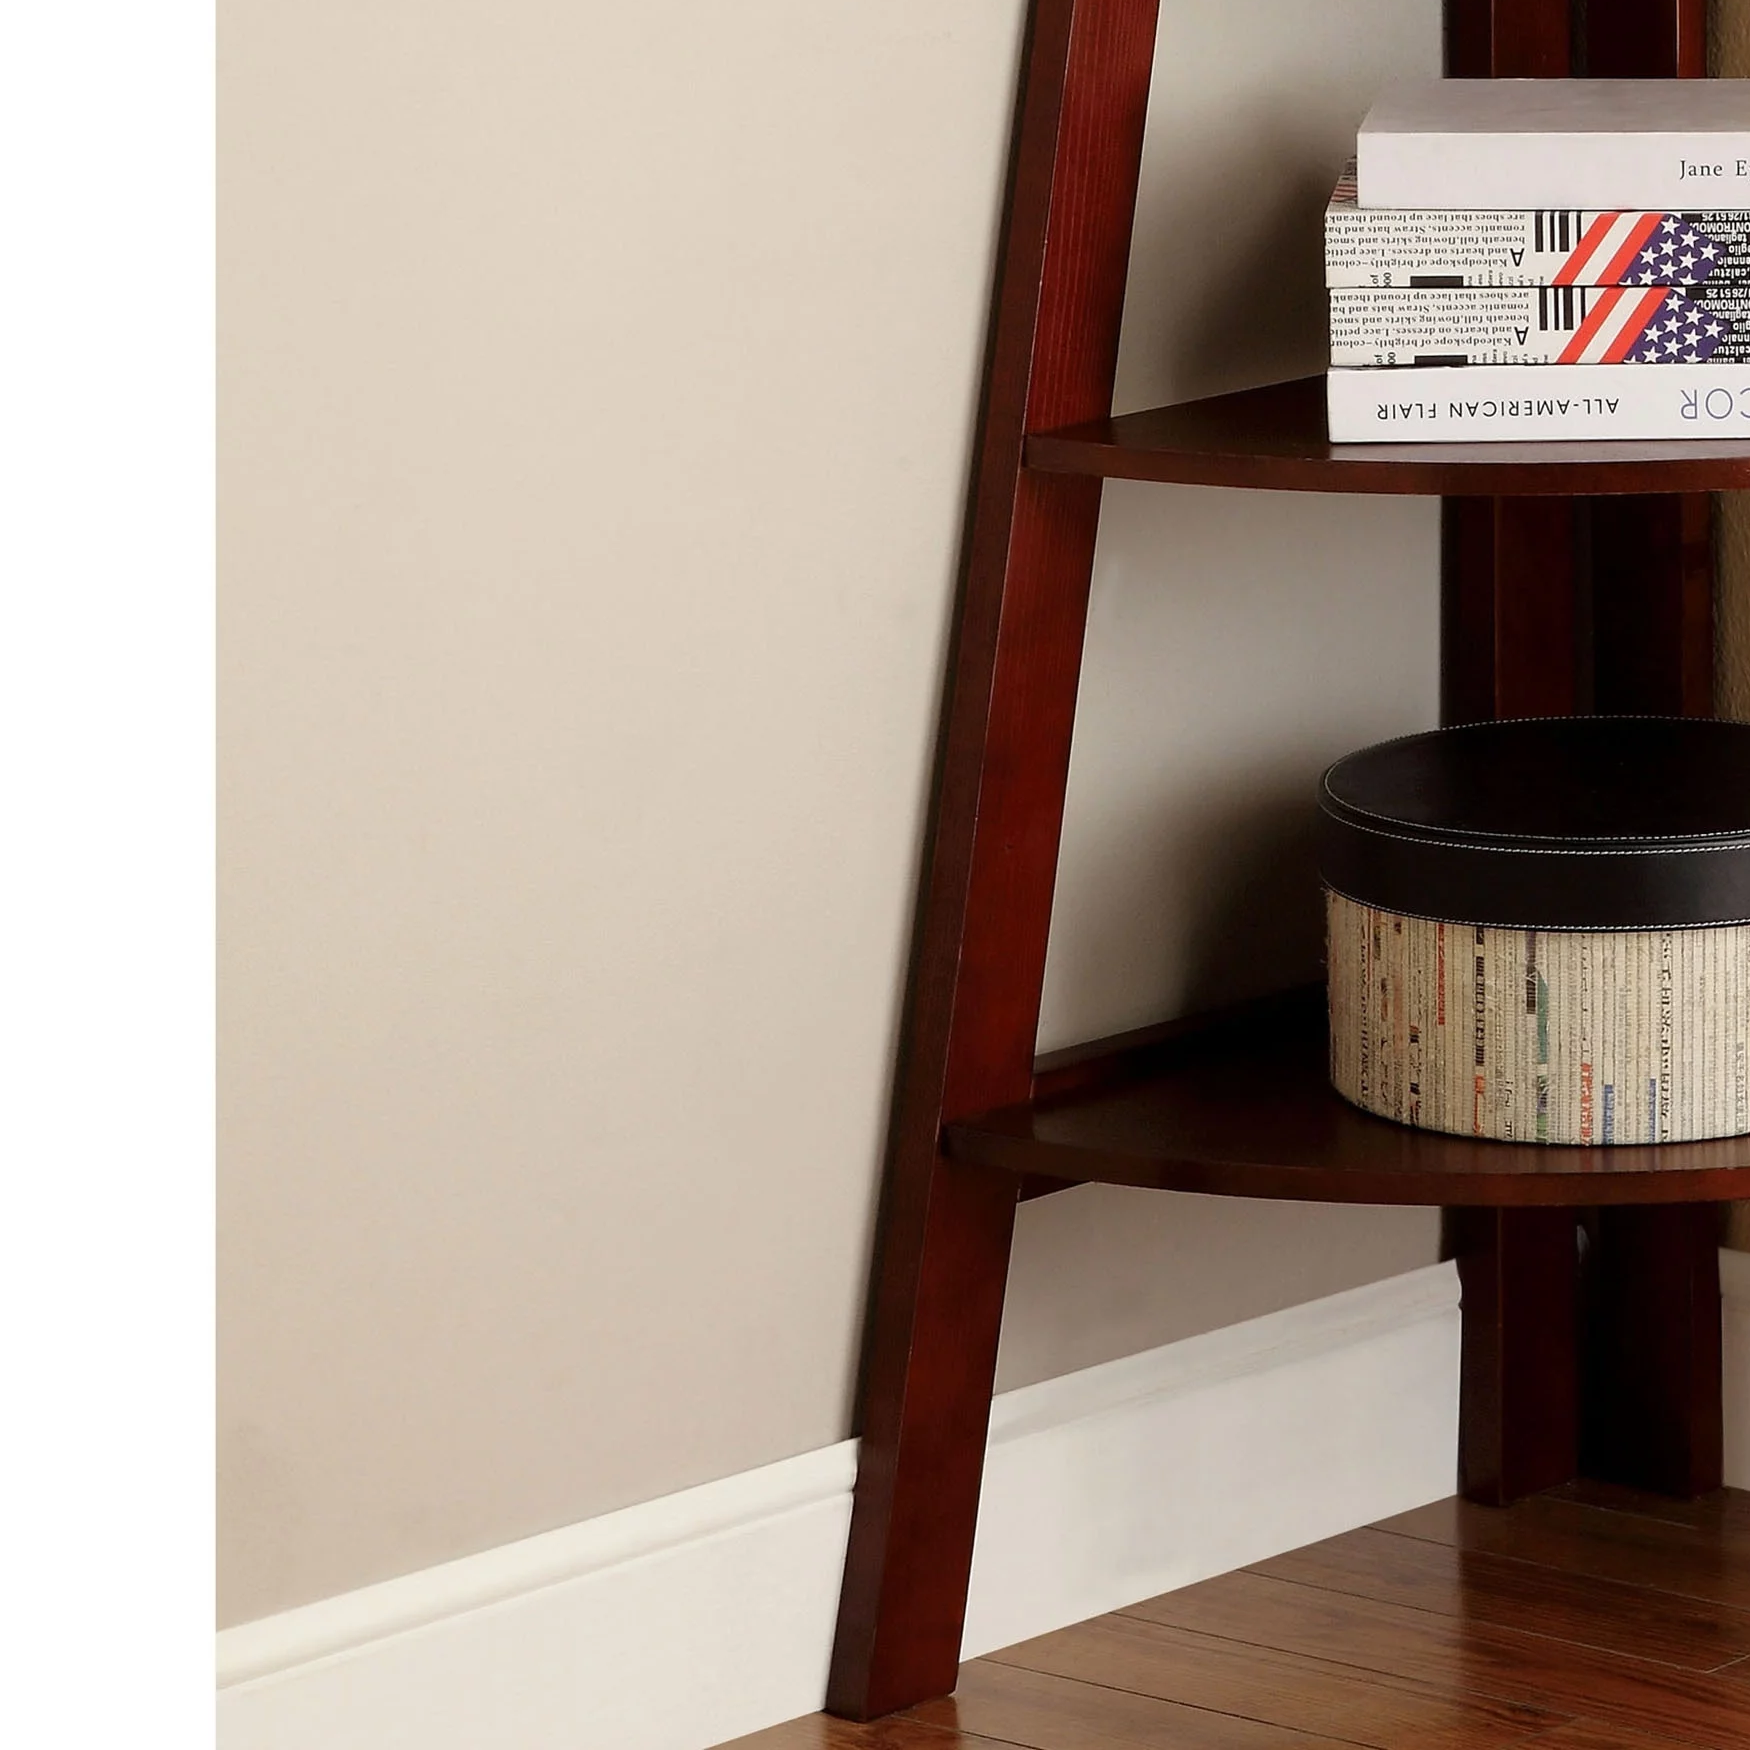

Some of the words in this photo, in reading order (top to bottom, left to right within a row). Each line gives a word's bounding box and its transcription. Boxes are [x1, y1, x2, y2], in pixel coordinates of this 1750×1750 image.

[1679, 160, 1723, 180] Jane
[1410, 213, 1422, 221] up
[1425, 214, 1447, 223] lace
[1451, 214, 1473, 222] that
[1476, 214, 1504, 222] shoes
[1344, 226, 1365, 234] and
[1367, 226, 1390, 234] hats
[1394, 225, 1425, 234] Straw
[1475, 225, 1525, 234] romantic
[1358, 237, 1378, 245] and
[1381, 236, 1412, 245] skirts
[1482, 236, 1525, 245] beneath
[1359, 248, 1384, 257] Lace
[1450, 248, 1484, 256] hearts
[1487, 248, 1508, 256] and
[1510, 248, 1524, 267] A
[1416, 259, 1427, 267] of
[1414, 292, 1427, 300] up
[1429, 293, 1451, 301] lace
[1455, 293, 1476, 301] that
[1479, 293, 1508, 301] shoes
[1371, 305, 1394, 313] hats
[1398, 304, 1429, 313] Straw
[1480, 304, 1529, 312] romantic
[1385, 316, 1416, 324] skirts
[1486, 315, 1529, 323] beneath
[1363, 328, 1389, 336] Lace
[1454, 326, 1488, 335] hearts
[1492, 326, 1512, 335] and
[1514, 326, 1529, 345] A
[1420, 338, 1431, 347] of
[1376, 402, 1437, 420] FLAIR
[1449, 396, 1619, 420] ALL-AMERICAN
